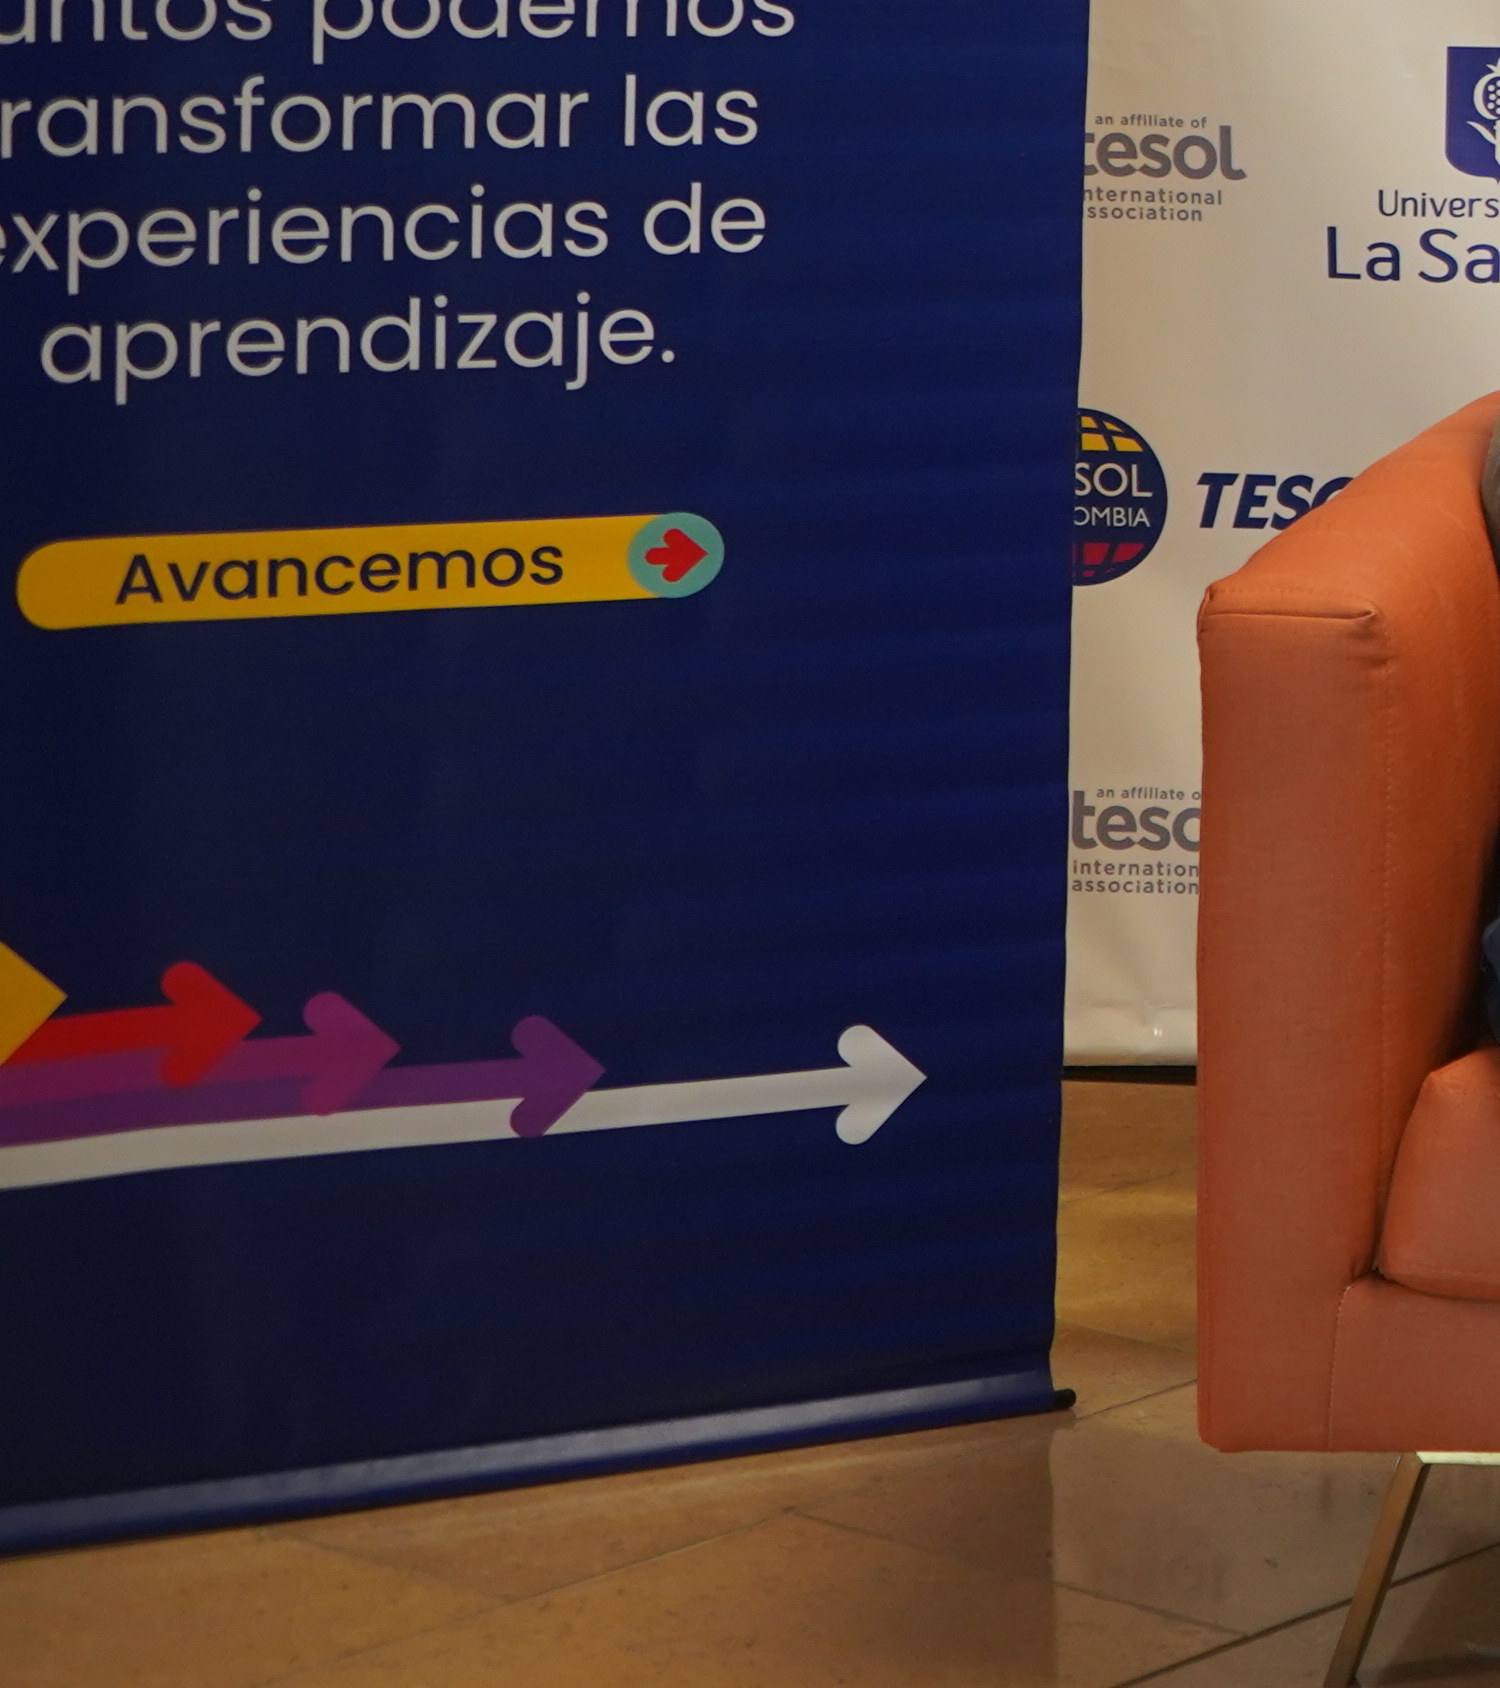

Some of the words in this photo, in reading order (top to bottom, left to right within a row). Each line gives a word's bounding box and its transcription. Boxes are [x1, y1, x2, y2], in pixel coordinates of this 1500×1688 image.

[0, 75, 590, 159] ransformar
[624, 73, 758, 147] las
[1095, 115, 1114, 125] an
[1120, 114, 1184, 128] affiliate
[1191, 117, 1207, 129] of
[1084, 187, 1222, 205] nternational
[1088, 206, 1202, 221] ssociation
[0, 183, 609, 295] xperiencias
[643, 181, 766, 255] de
[1326, 226, 1400, 282] La
[40, 291, 675, 406] aprendizaje.
[1075, 462, 1152, 498] SOL
[1074, 506, 1150, 528] OMBIA
[1197, 472, 1354, 530] TES
[114, 545, 564, 606] Avancemos
[1096, 788, 1114, 798] an
[1121, 787, 1184, 800] affiliate
[1192, 791, 1201, 800] o
[1072, 790, 1201, 852] teso
[1072, 860, 1198, 877] internation
[1072, 880, 1198, 894] association
